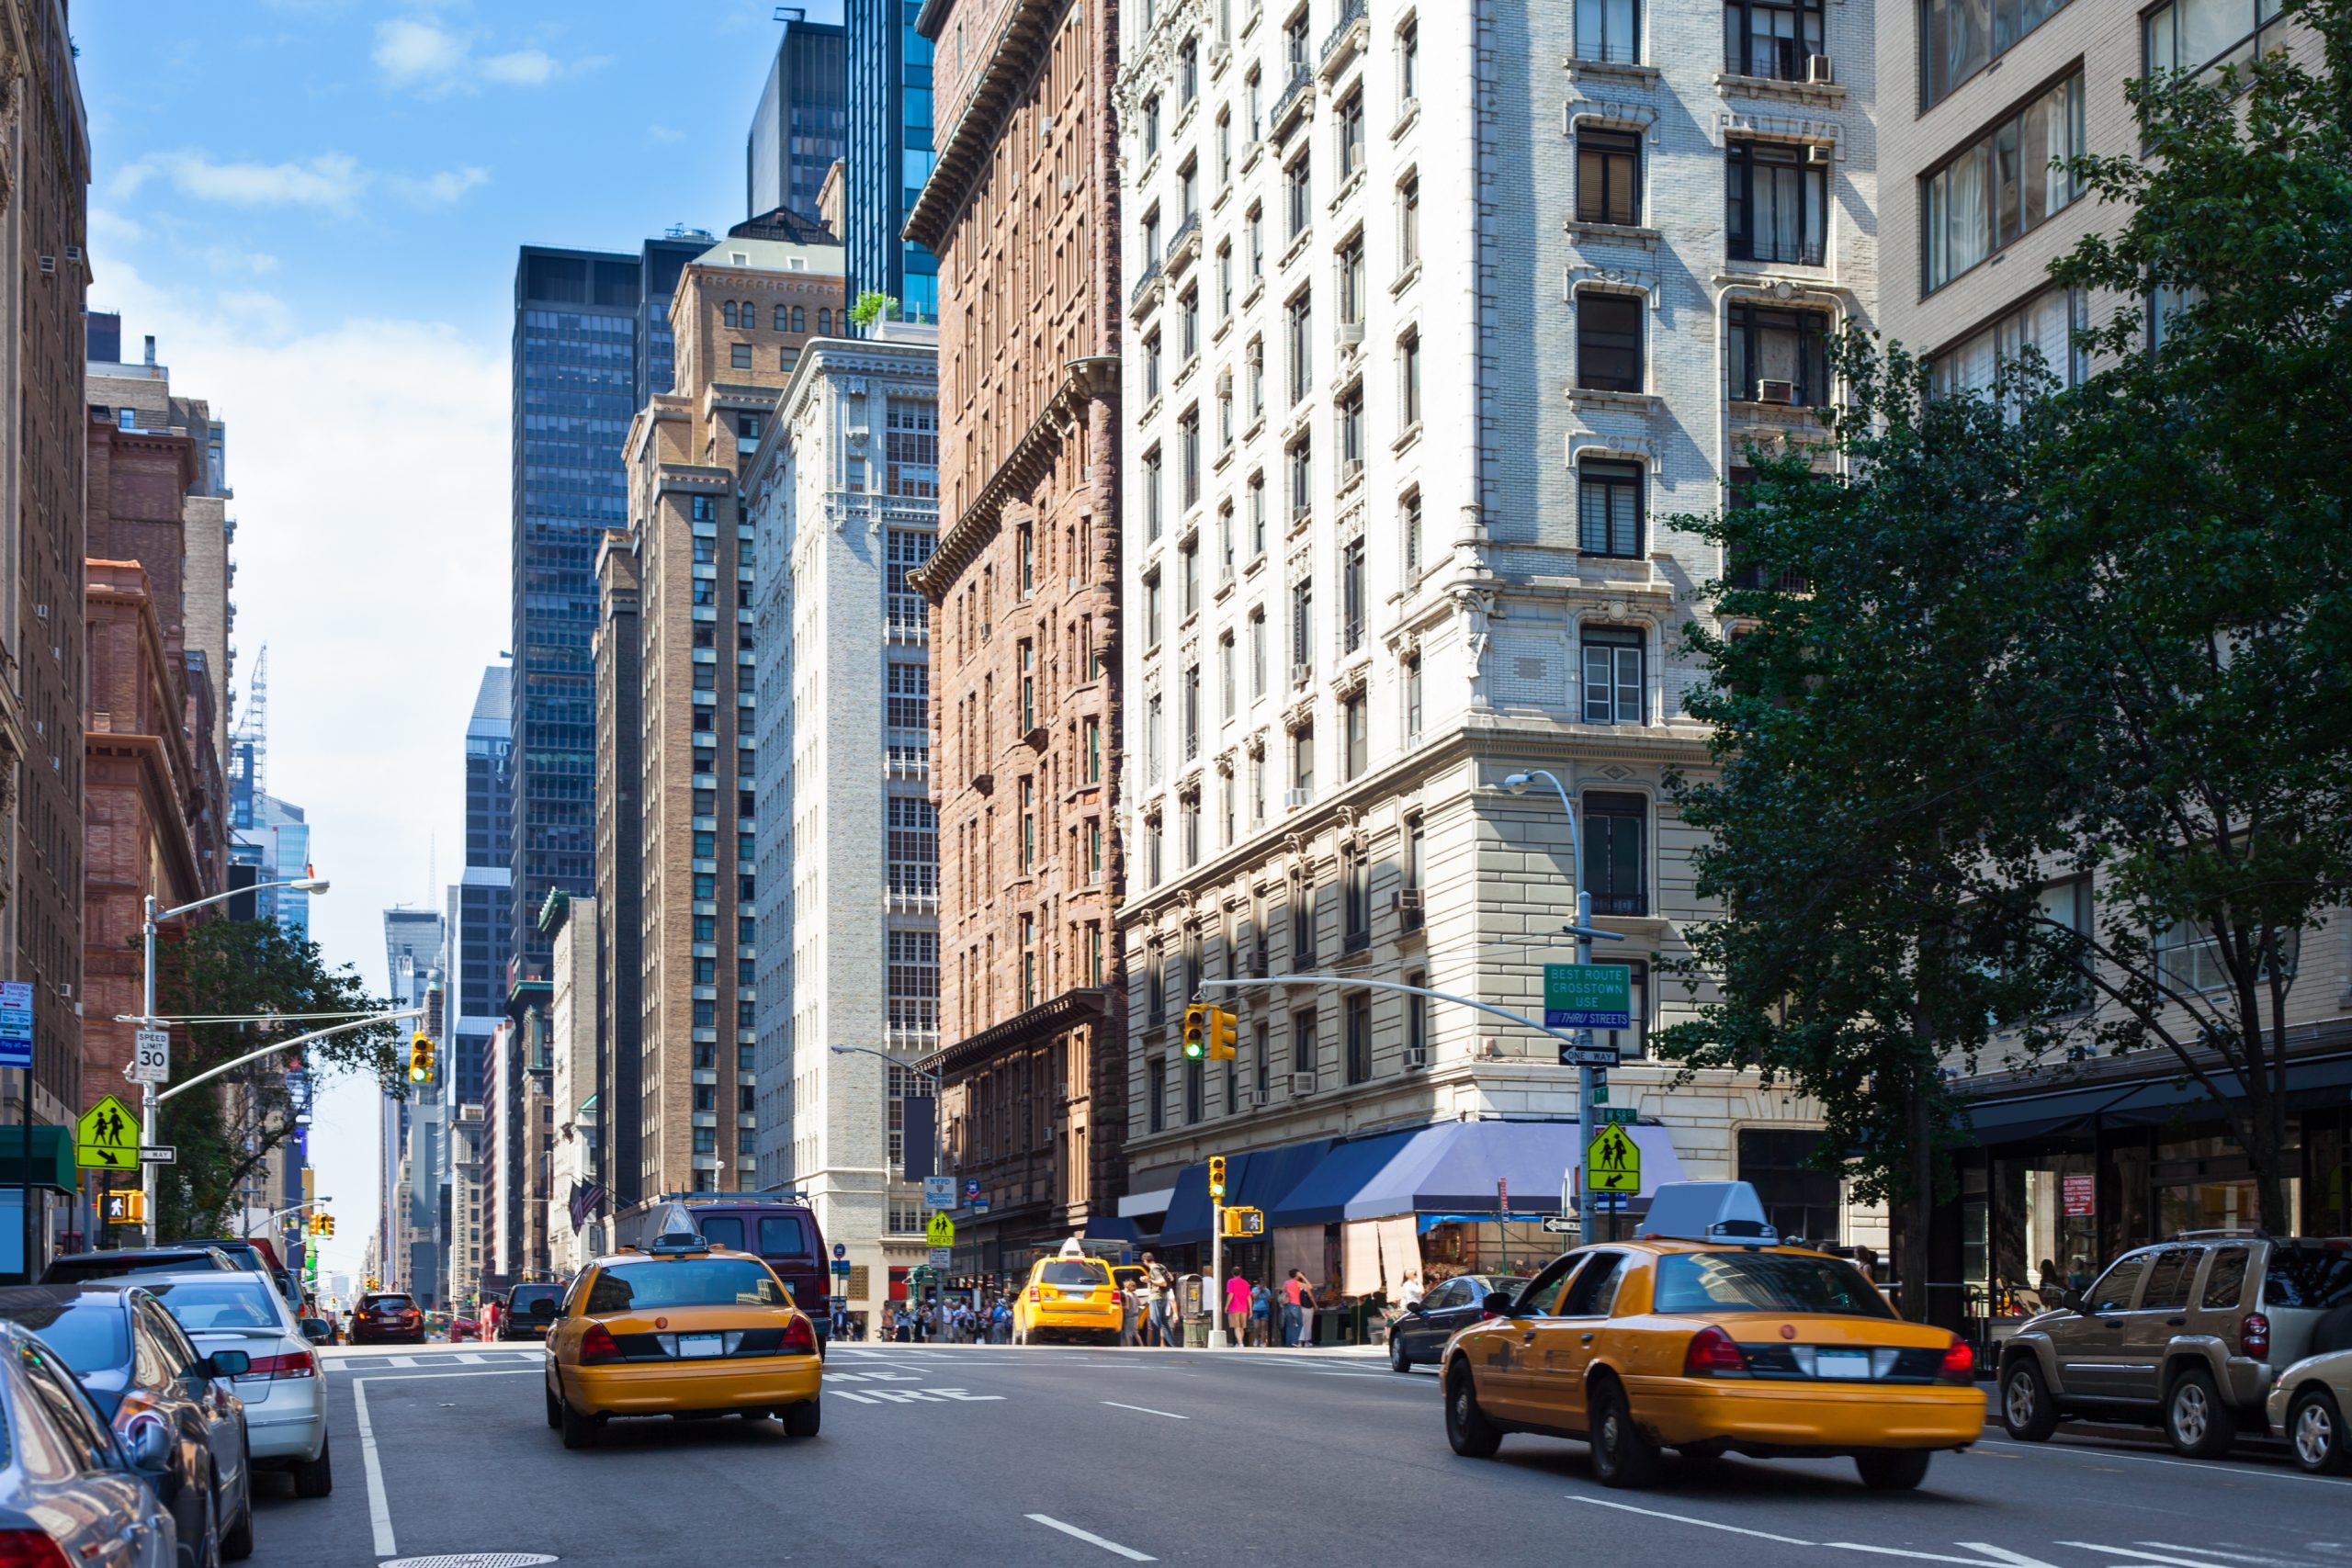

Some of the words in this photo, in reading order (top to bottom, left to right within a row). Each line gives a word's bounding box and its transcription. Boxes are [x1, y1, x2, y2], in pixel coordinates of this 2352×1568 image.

[1551, 969, 1580, 979] BEST
[1585, 970, 1623, 980] ROUTE
[1552, 983, 1623, 994] CROSSTOWN
[1576, 997, 1599, 1008] USE
[1561, 1012, 1588, 1023] THRU
[1589, 1013, 1628, 1024] STREETS
[139, 1033, 166, 1043] SPEED
[140, 1051, 165, 1066] 30
[1567, 1051, 1586, 1060] ONE
[1593, 1053, 1612, 1061] WAY
[1606, 1110, 1614, 1121] W
